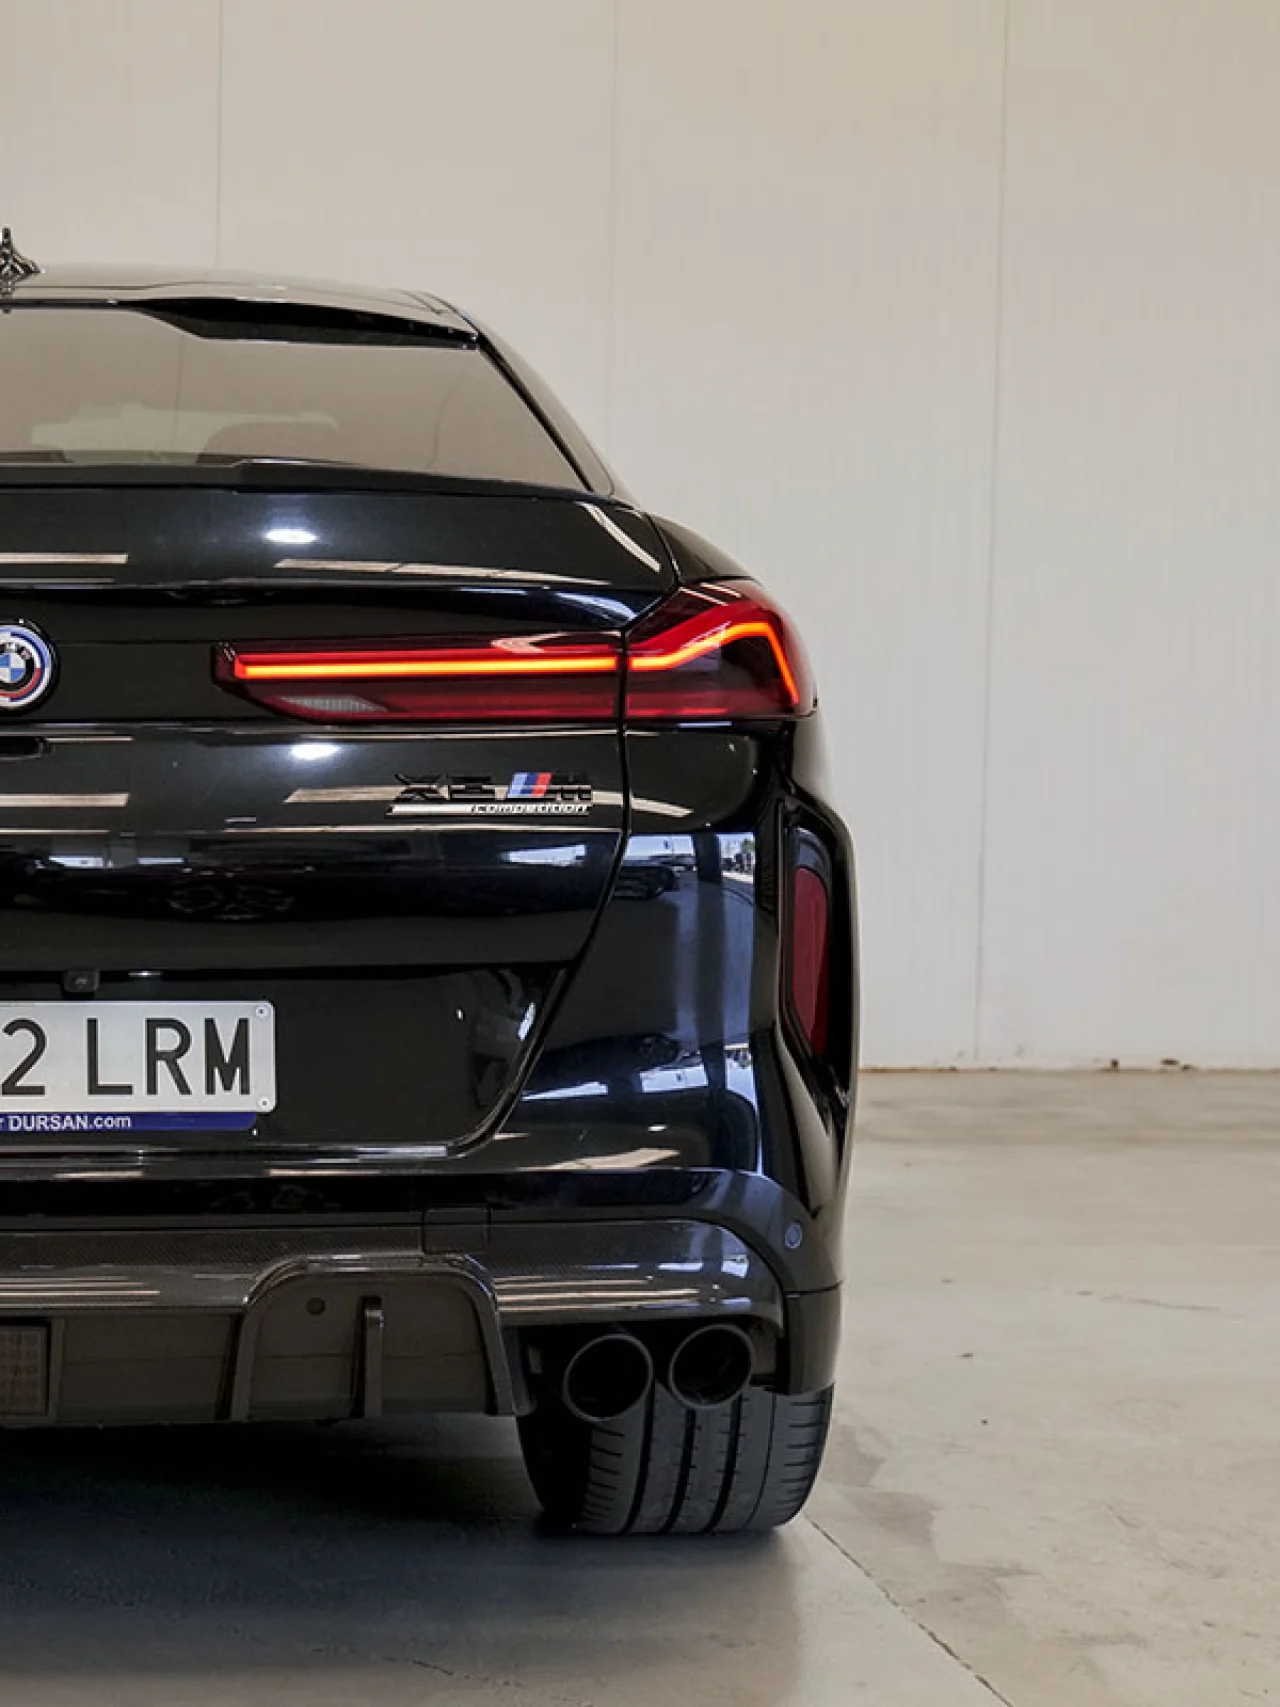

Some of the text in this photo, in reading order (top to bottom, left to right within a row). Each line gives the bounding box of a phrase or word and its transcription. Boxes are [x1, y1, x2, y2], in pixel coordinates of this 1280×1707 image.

[471, 803, 590, 816] competition
[86, 1017, 252, 1097] LRM
[7, 1113, 132, 1132] DURSAN.com
